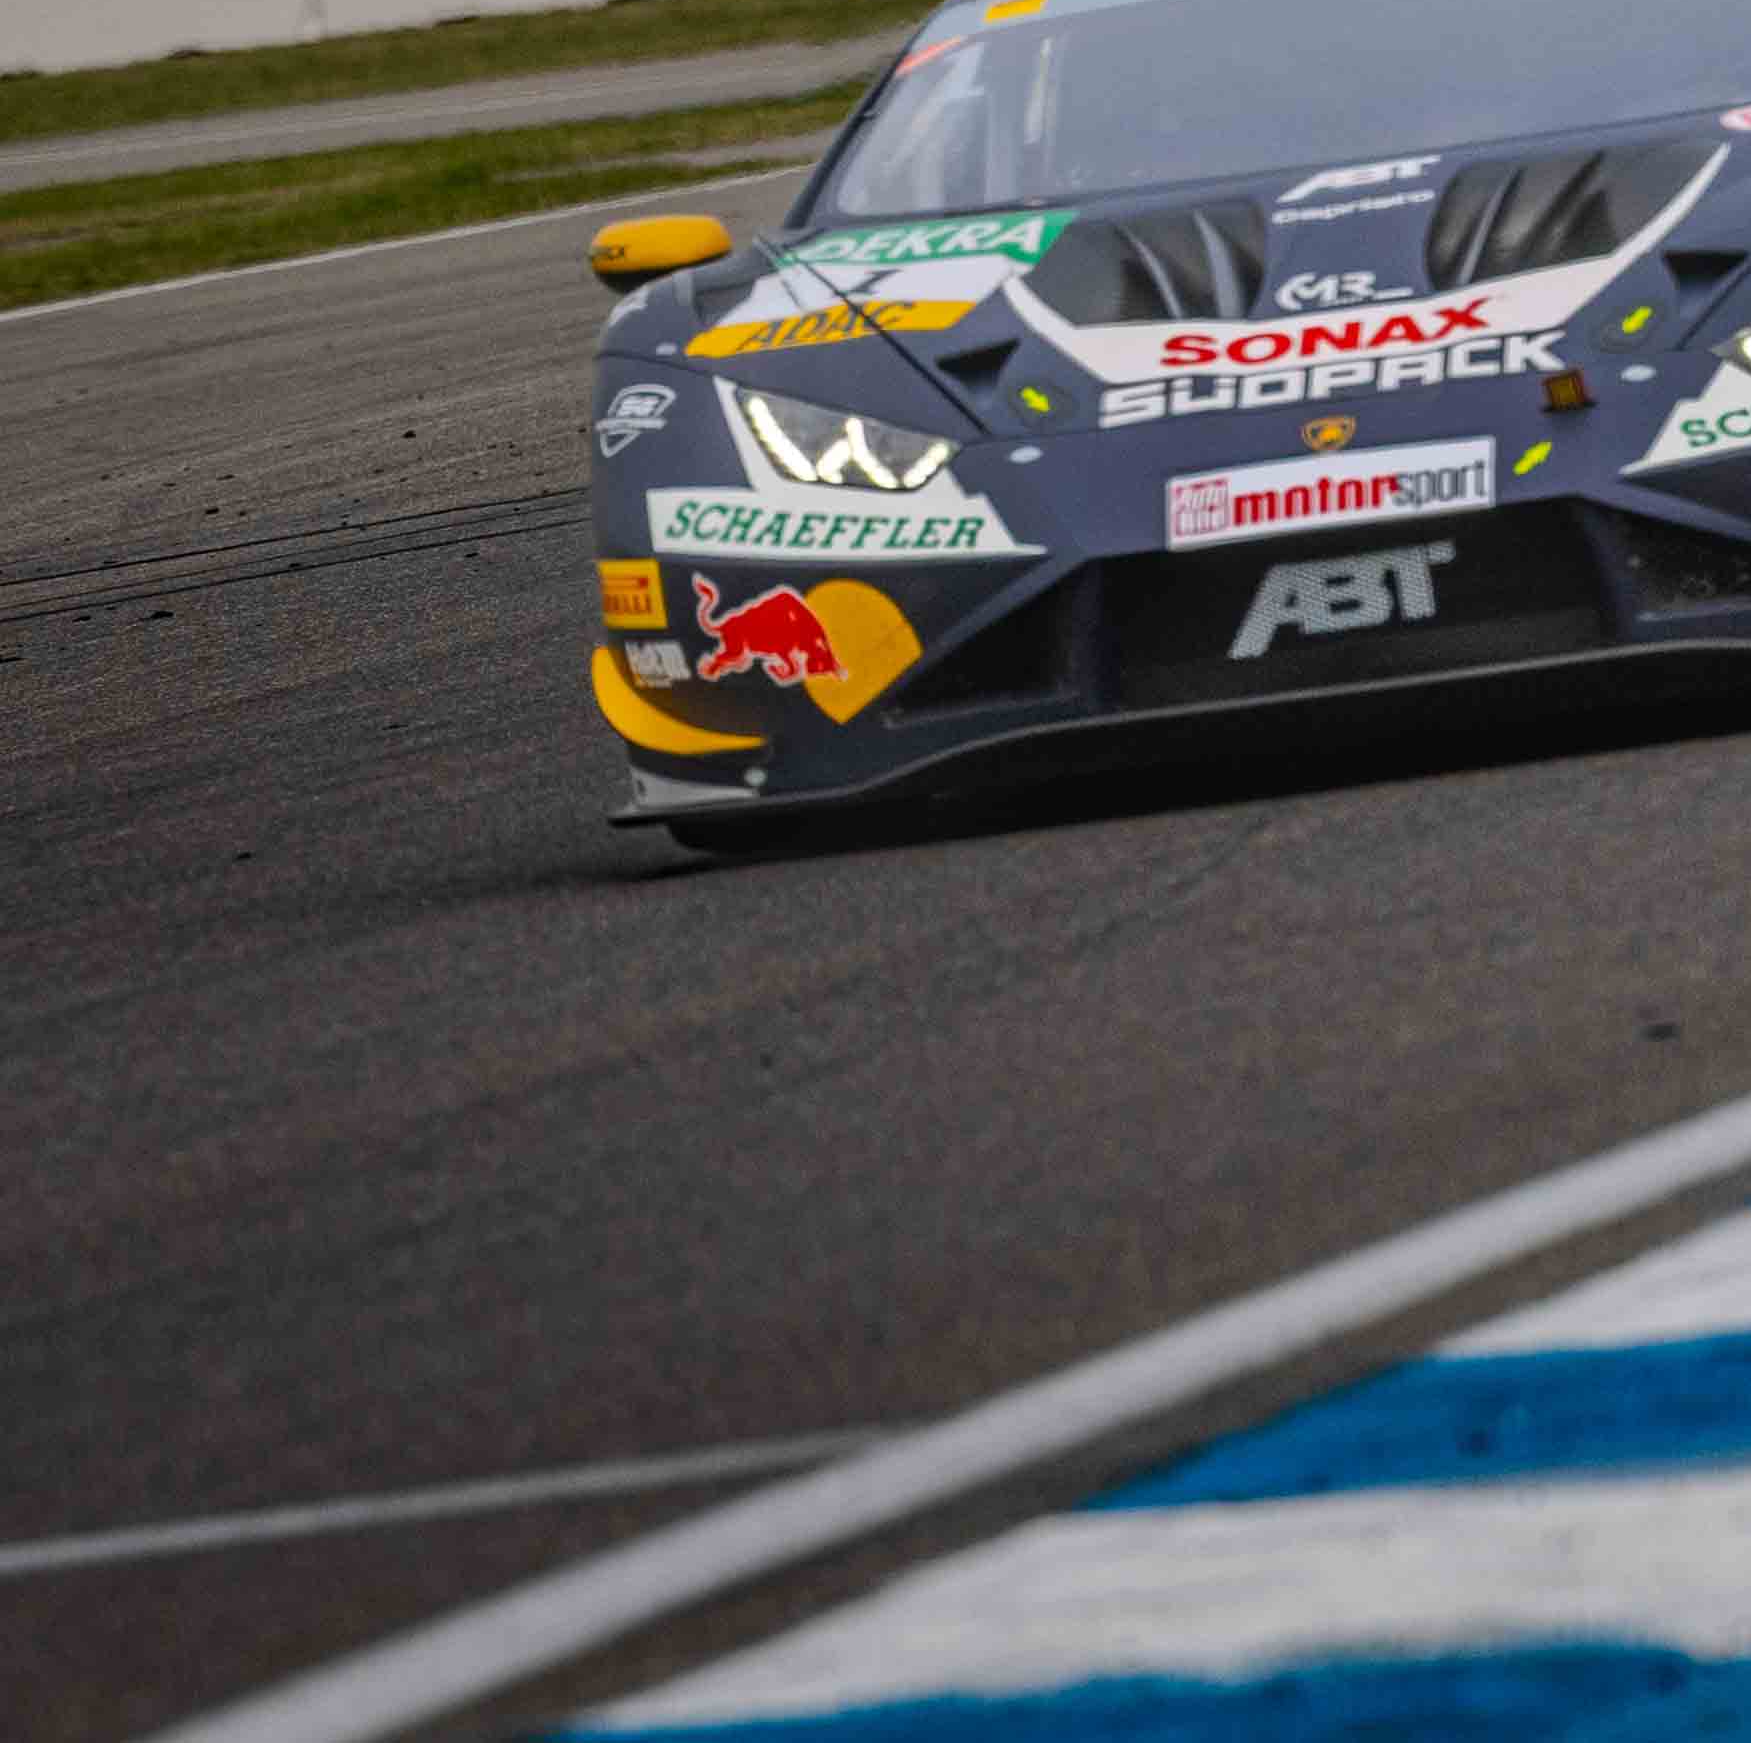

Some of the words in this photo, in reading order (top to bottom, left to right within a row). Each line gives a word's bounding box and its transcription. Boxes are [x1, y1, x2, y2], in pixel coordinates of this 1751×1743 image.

[805, 216, 1047, 261] DEKRA
[736, 302, 916, 352] ADAC
[1160, 297, 1491, 368] SONAX
[1233, 459, 1487, 528] motorsport
[665, 500, 985, 550] SCHAEFFLER
[1227, 540, 1457, 660] ABT
